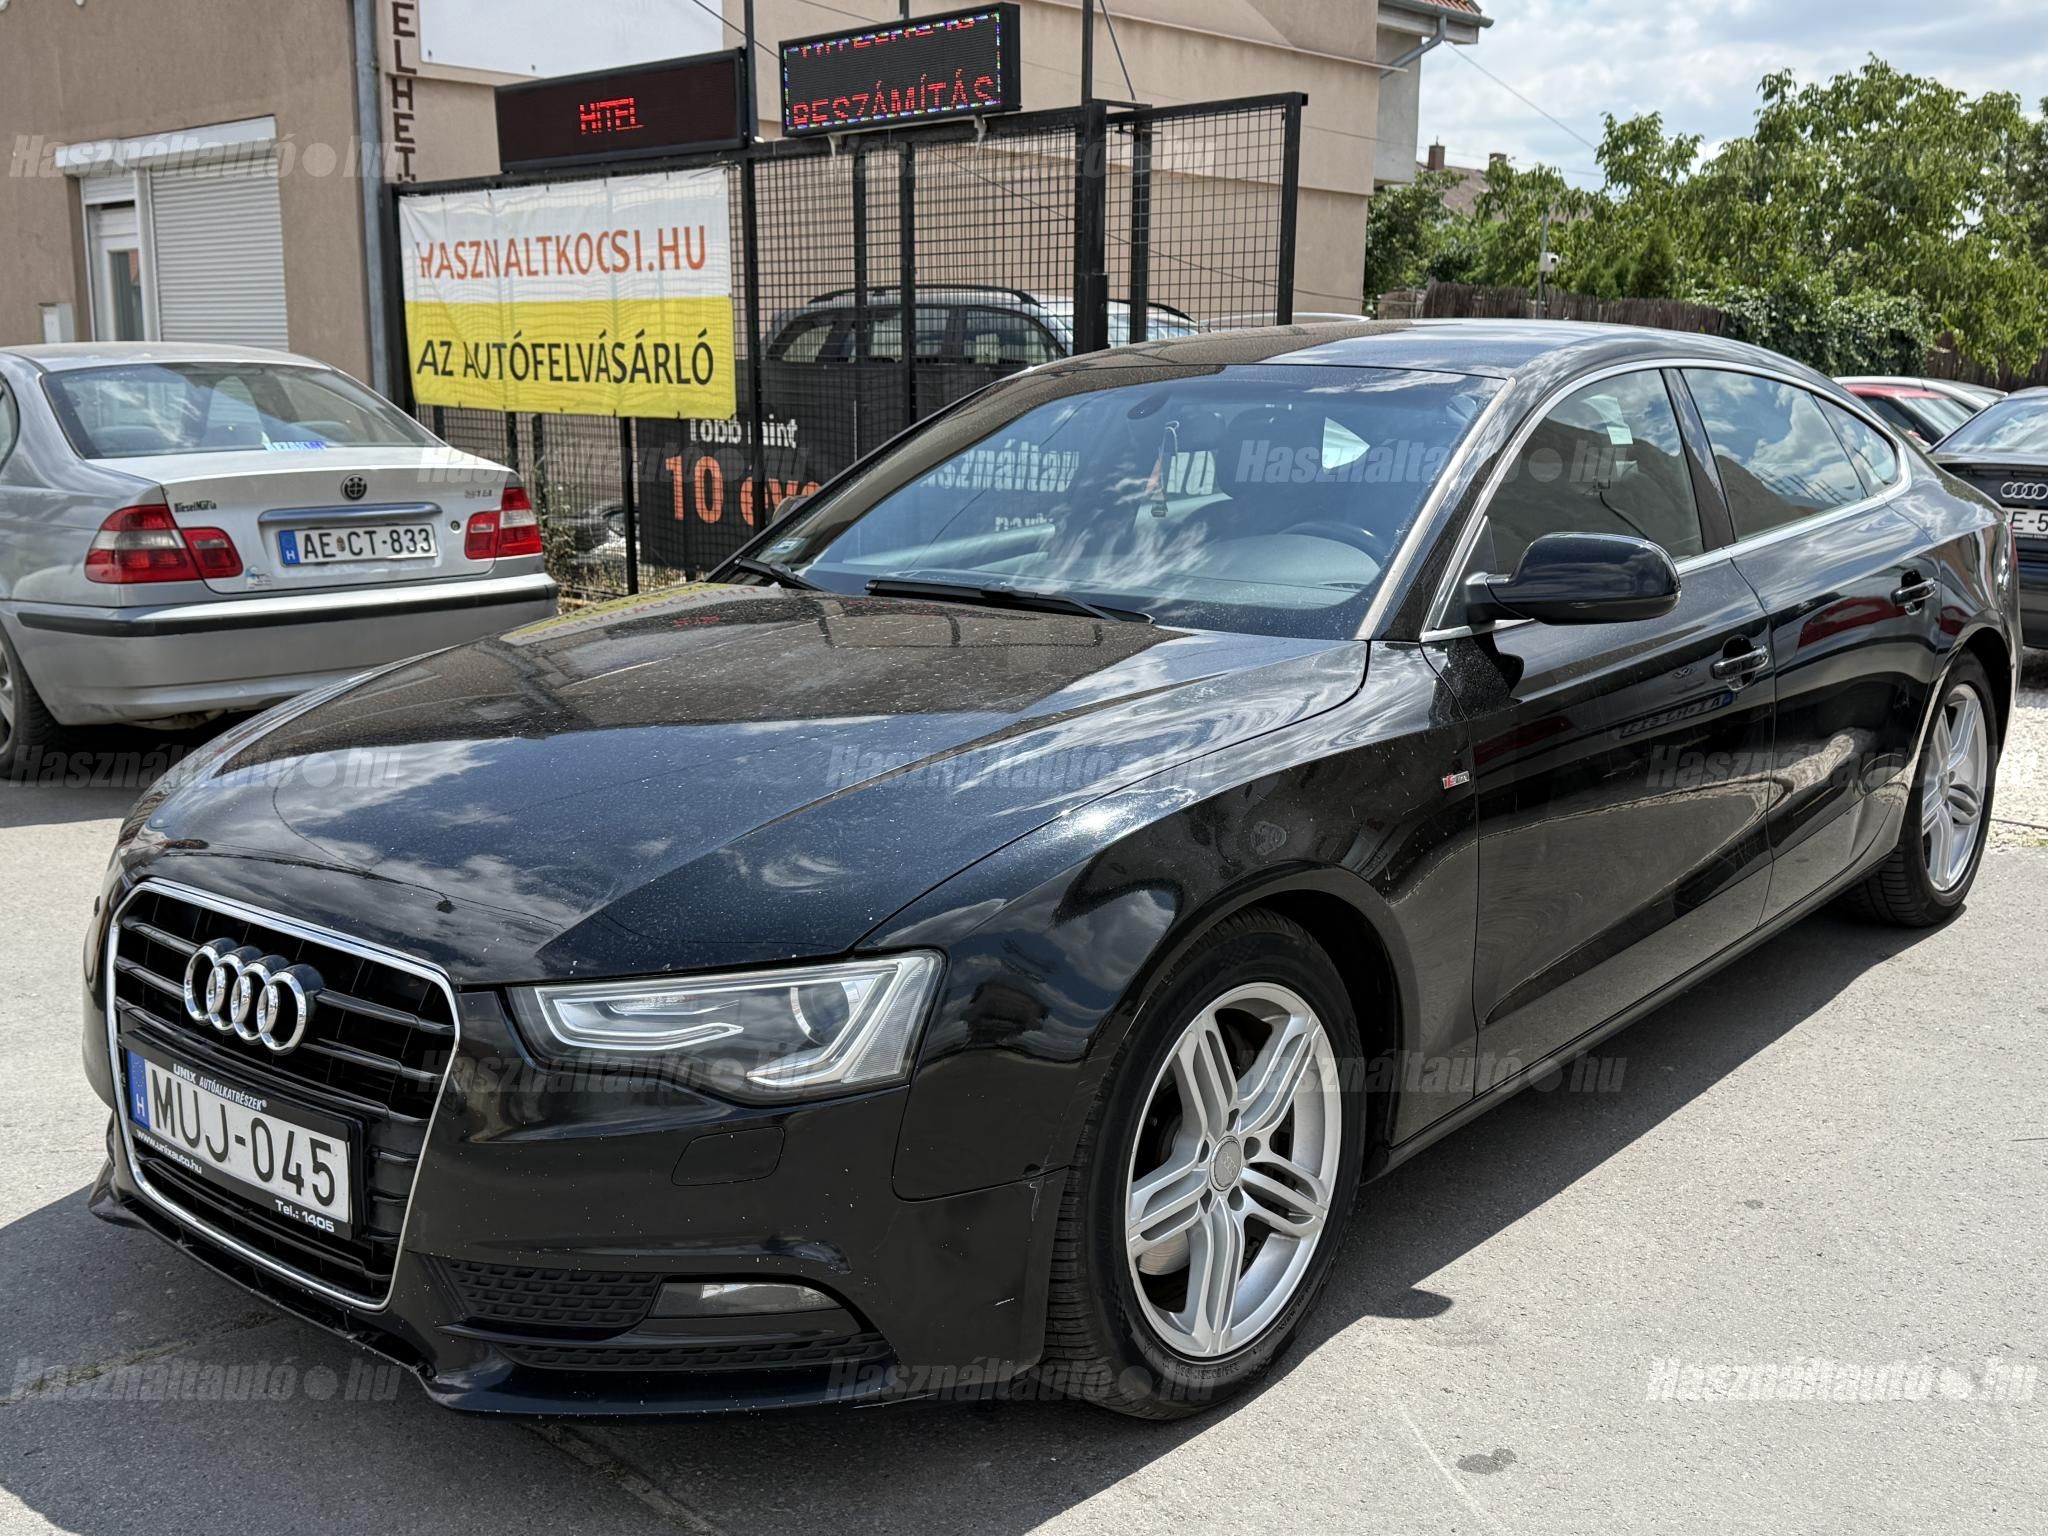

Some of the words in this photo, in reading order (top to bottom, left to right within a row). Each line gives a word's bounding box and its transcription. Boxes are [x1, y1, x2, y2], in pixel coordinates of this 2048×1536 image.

[416, 225, 706, 279] HASZNALTKOCSI.HU
[416, 339, 454, 376] AZ
[463, 328, 714, 385] AUTÓFELVÁSÁRLÓ
[665, 455, 724, 524] 10
[286, 550, 296, 560] H
[304, 532, 336, 559] AE
[347, 528, 431, 556] CT-833
[136, 1093, 145, 1118] H
[151, 1068, 335, 1207] MUJ-045
[302, 1211, 335, 1233] 1405
